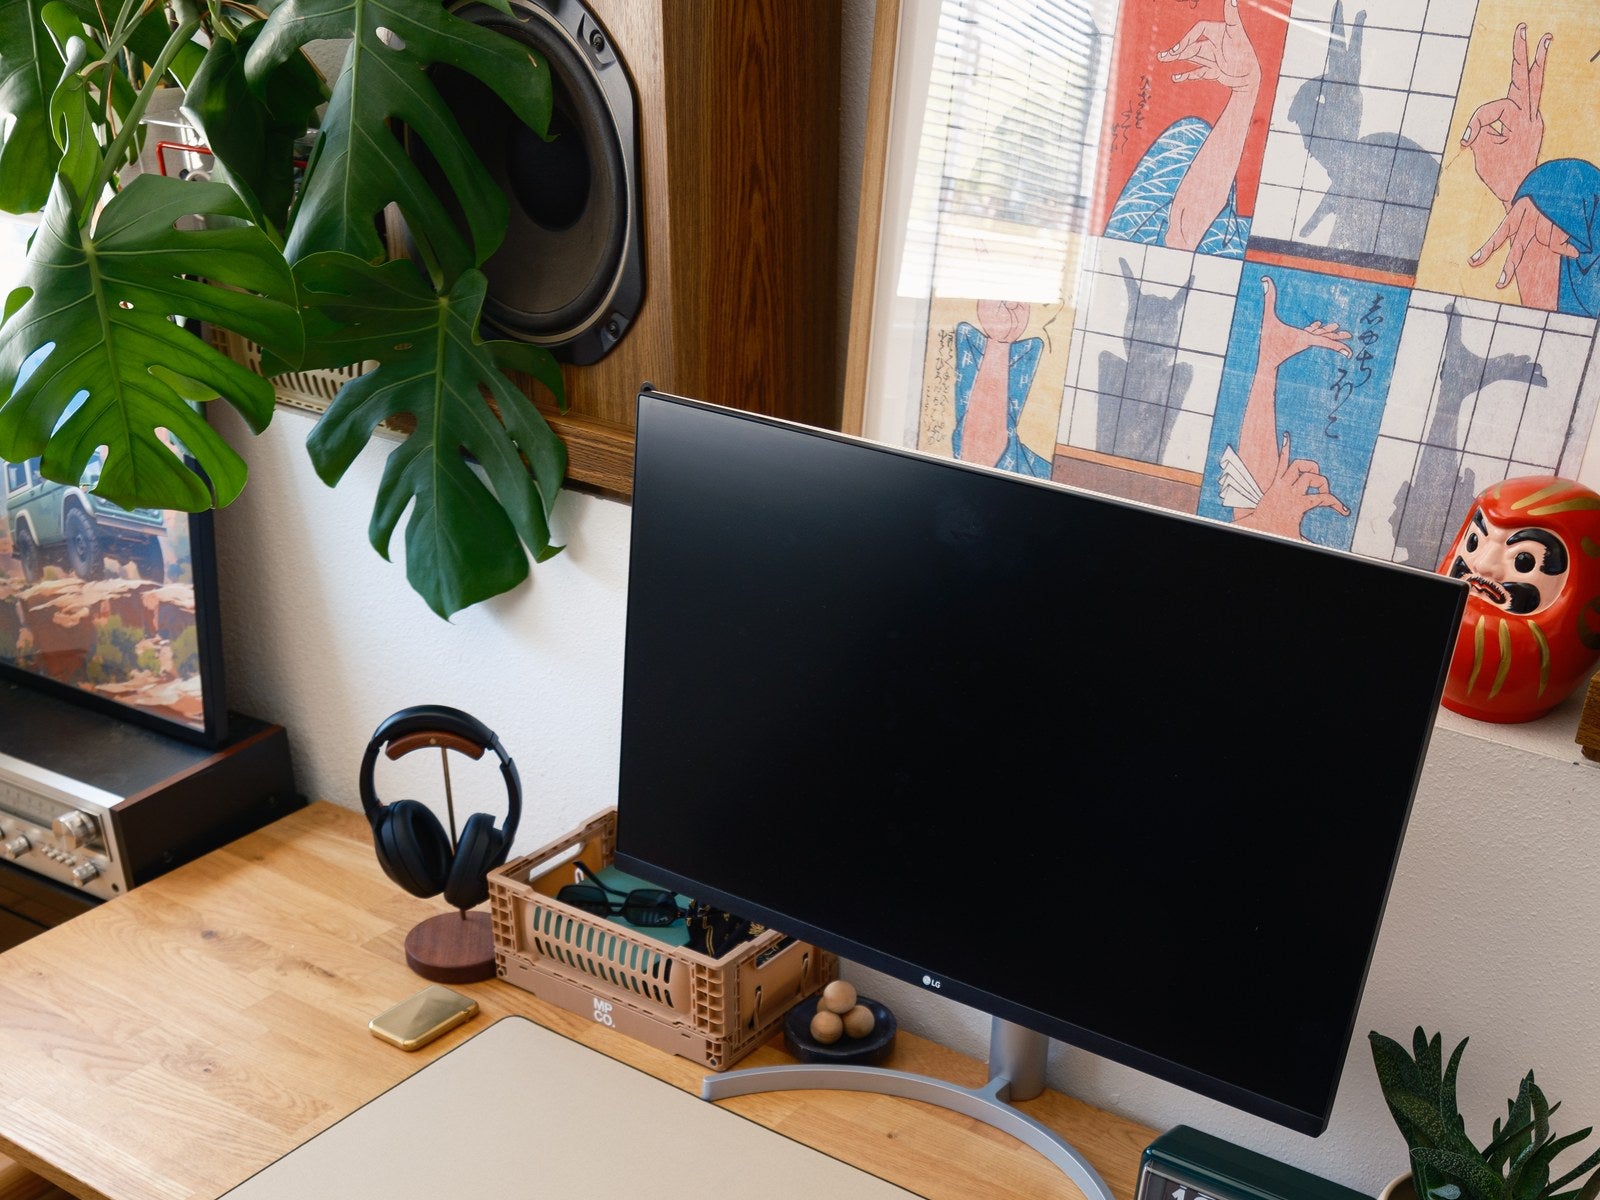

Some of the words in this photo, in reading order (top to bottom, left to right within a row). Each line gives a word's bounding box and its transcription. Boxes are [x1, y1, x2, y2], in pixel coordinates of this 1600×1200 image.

[931, 979, 941, 989] LG
[593, 997, 613, 1014] MP
[594, 1010, 616, 1028] CO.
